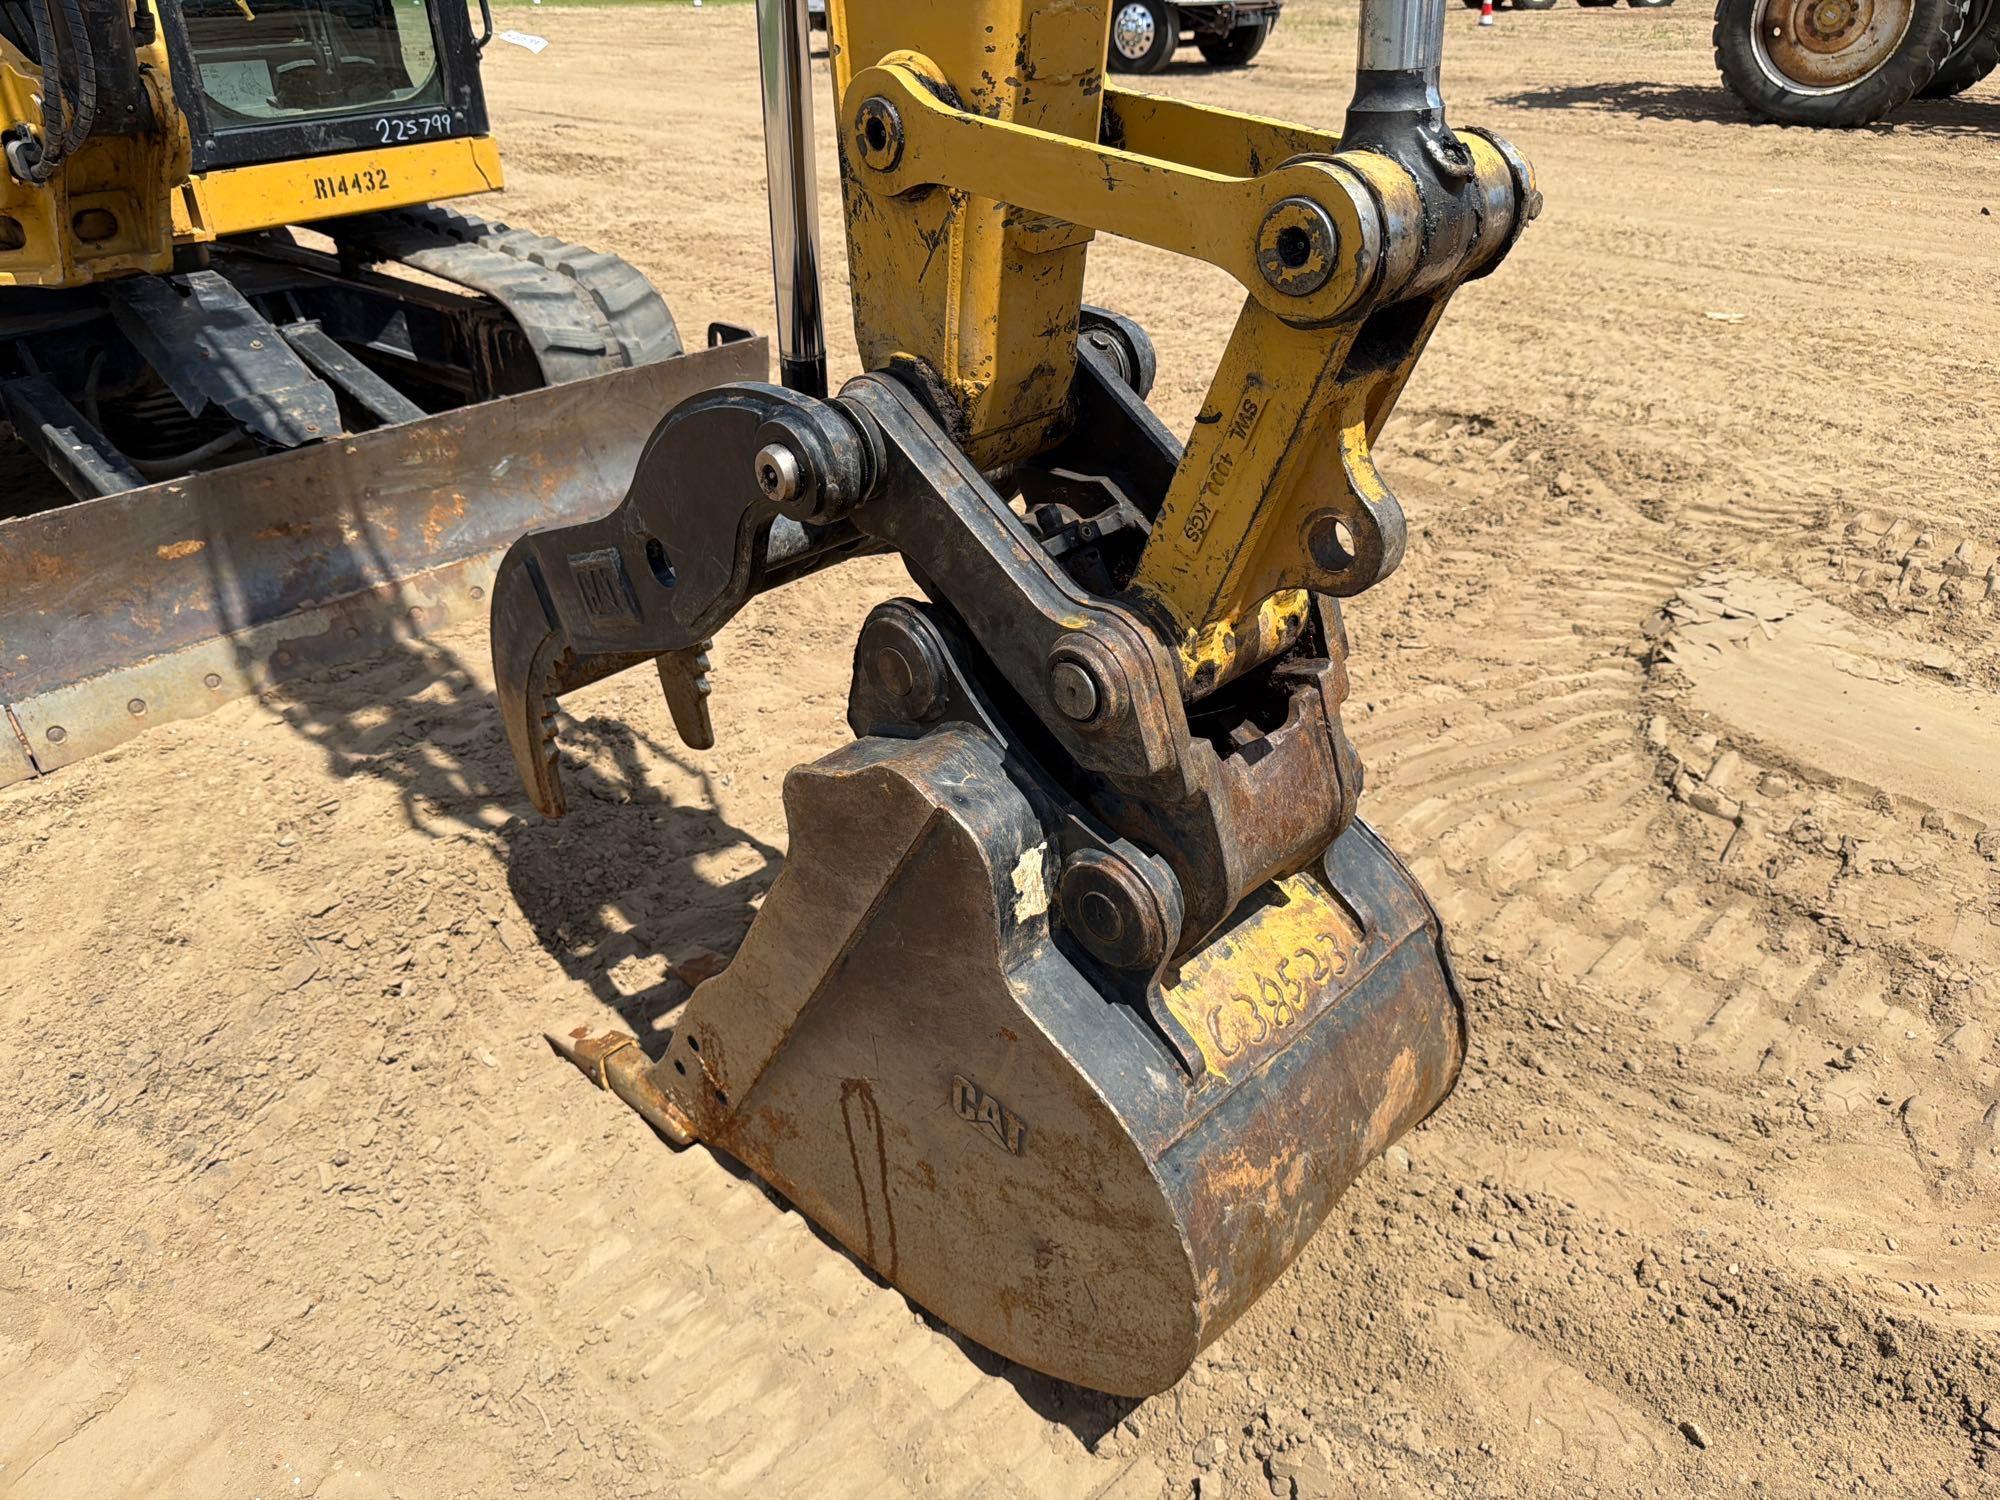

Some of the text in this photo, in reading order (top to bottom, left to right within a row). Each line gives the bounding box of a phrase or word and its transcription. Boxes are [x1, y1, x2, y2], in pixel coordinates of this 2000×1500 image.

[375, 114, 451, 144] 225799
[313, 168, 390, 200] R14432
[1229, 398, 1258, 440] SWL
[1183, 502, 1212, 543] KGS
[952, 1073, 1025, 1156] CAT
